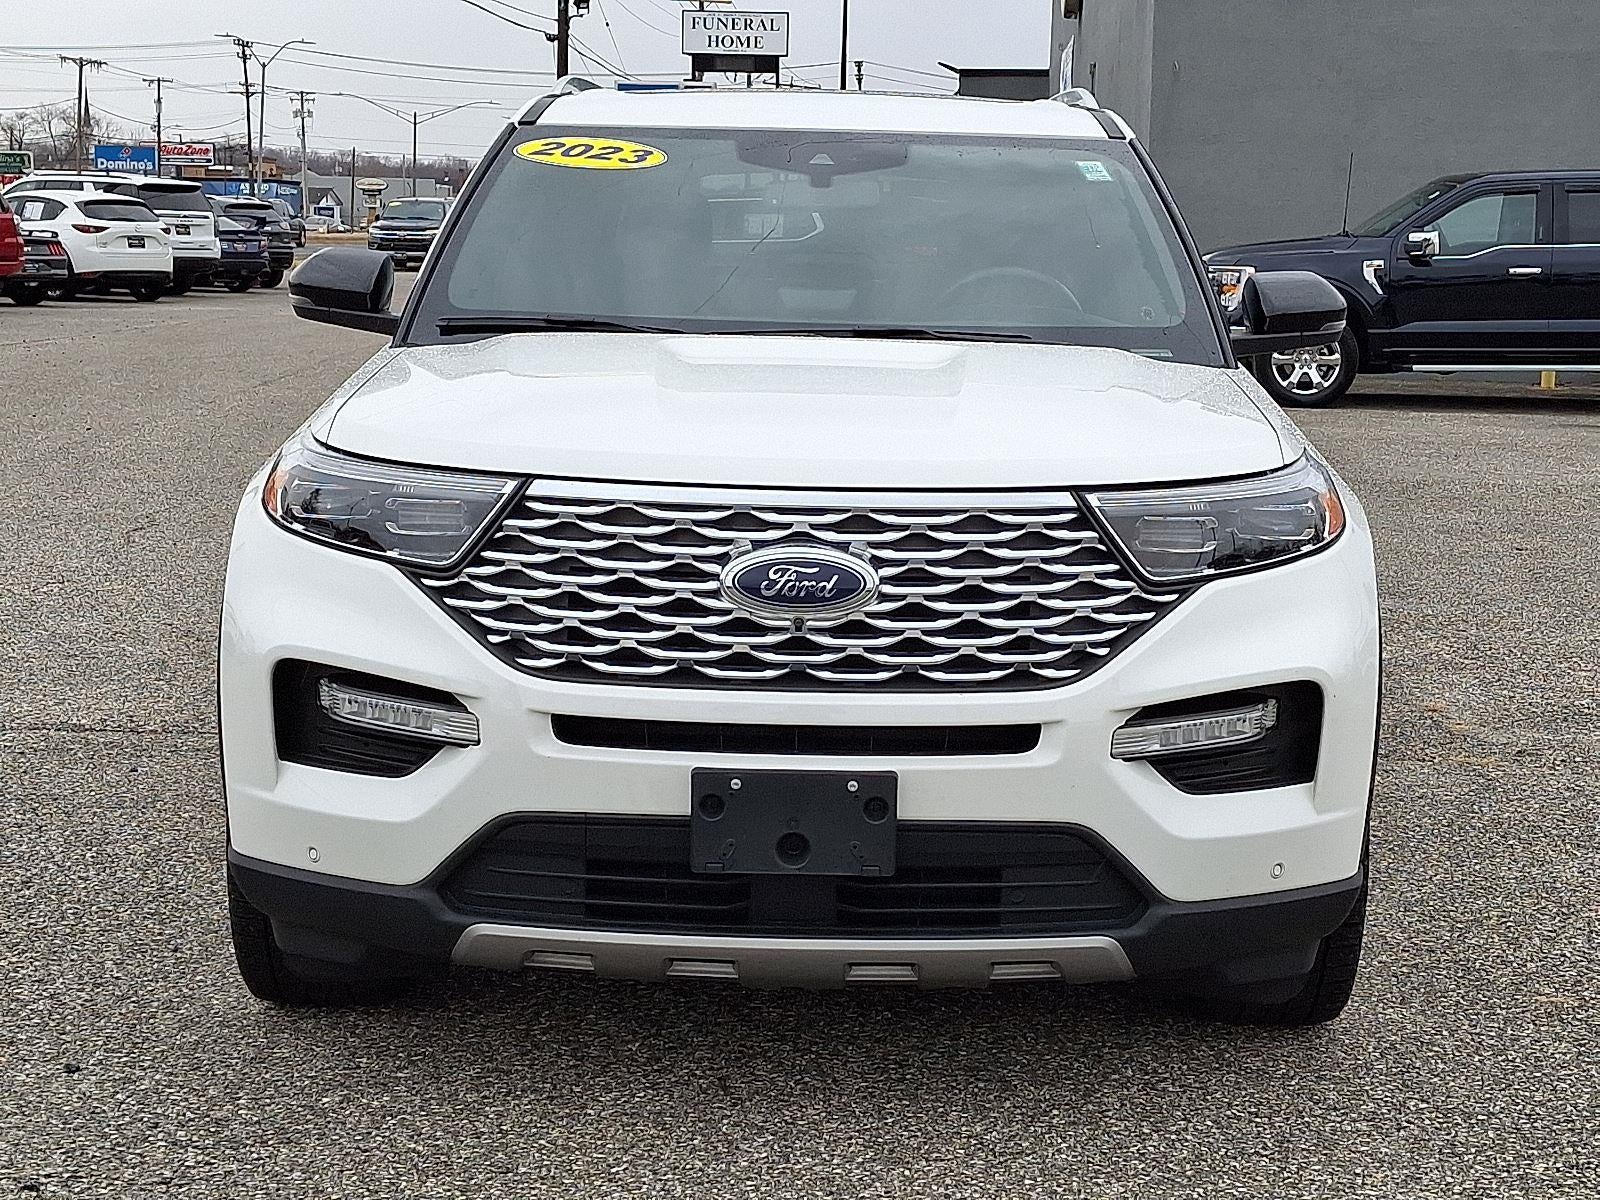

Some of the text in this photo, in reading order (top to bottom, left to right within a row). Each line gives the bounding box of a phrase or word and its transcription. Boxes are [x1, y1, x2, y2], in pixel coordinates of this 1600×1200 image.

[691, 16, 781, 32] FUNERAL
[707, 34, 765, 49] HOME
[527, 142, 654, 164] 2023
[97, 157, 153, 170] Domino's
[760, 564, 839, 598] Ford
